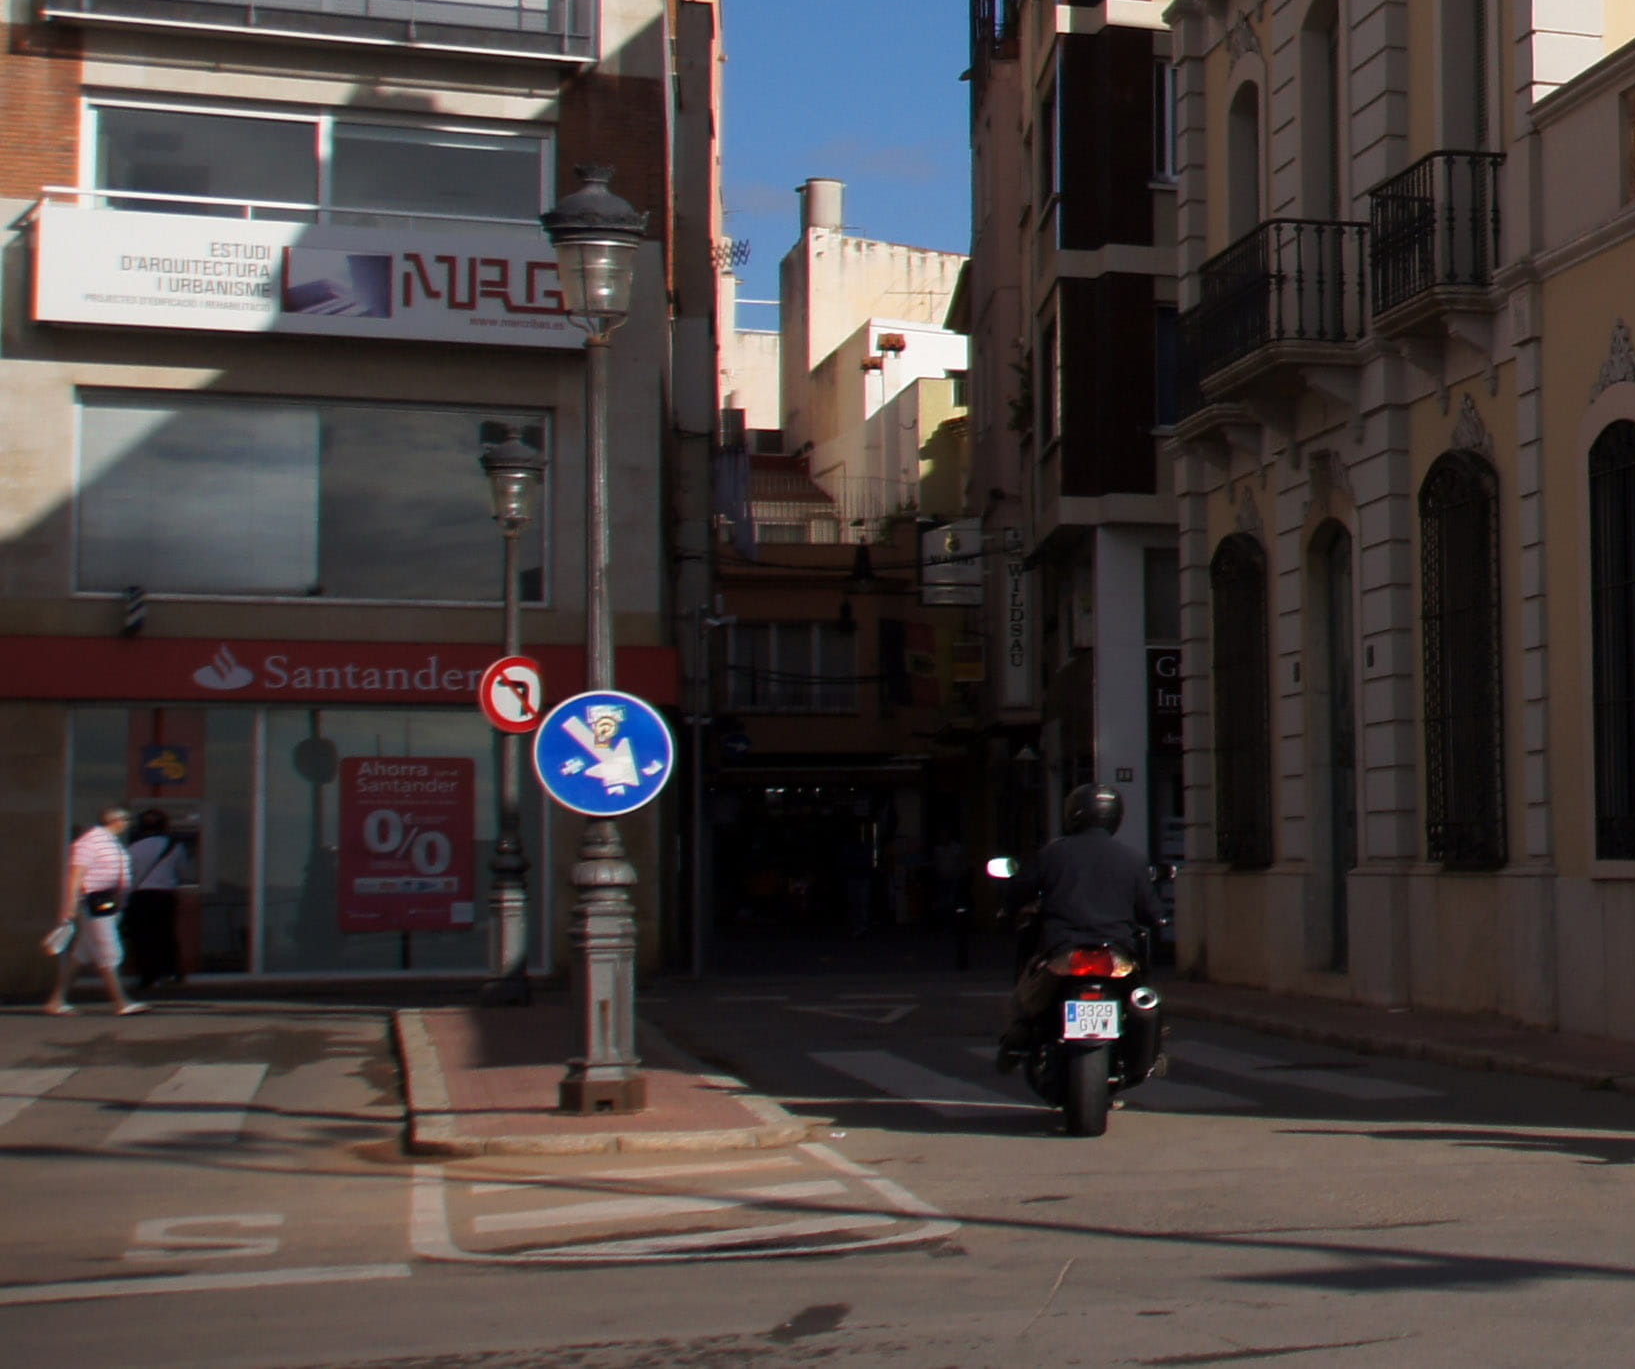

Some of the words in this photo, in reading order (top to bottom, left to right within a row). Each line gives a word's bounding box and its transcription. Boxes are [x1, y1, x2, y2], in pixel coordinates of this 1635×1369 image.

[211, 242, 271, 260] ESTUDI
[120, 255, 271, 279] D'ARQUITECTURA
[169, 278, 271, 298] URBANISME
[1007, 563, 1024, 668] WILDSAU
[263, 654, 484, 691] Santander
[358, 761, 430, 777] Ahorra
[356, 777, 459, 793] Santander
[1077, 1004, 1113, 1018] 3329
[1079, 1018, 1110, 1031] GVW
